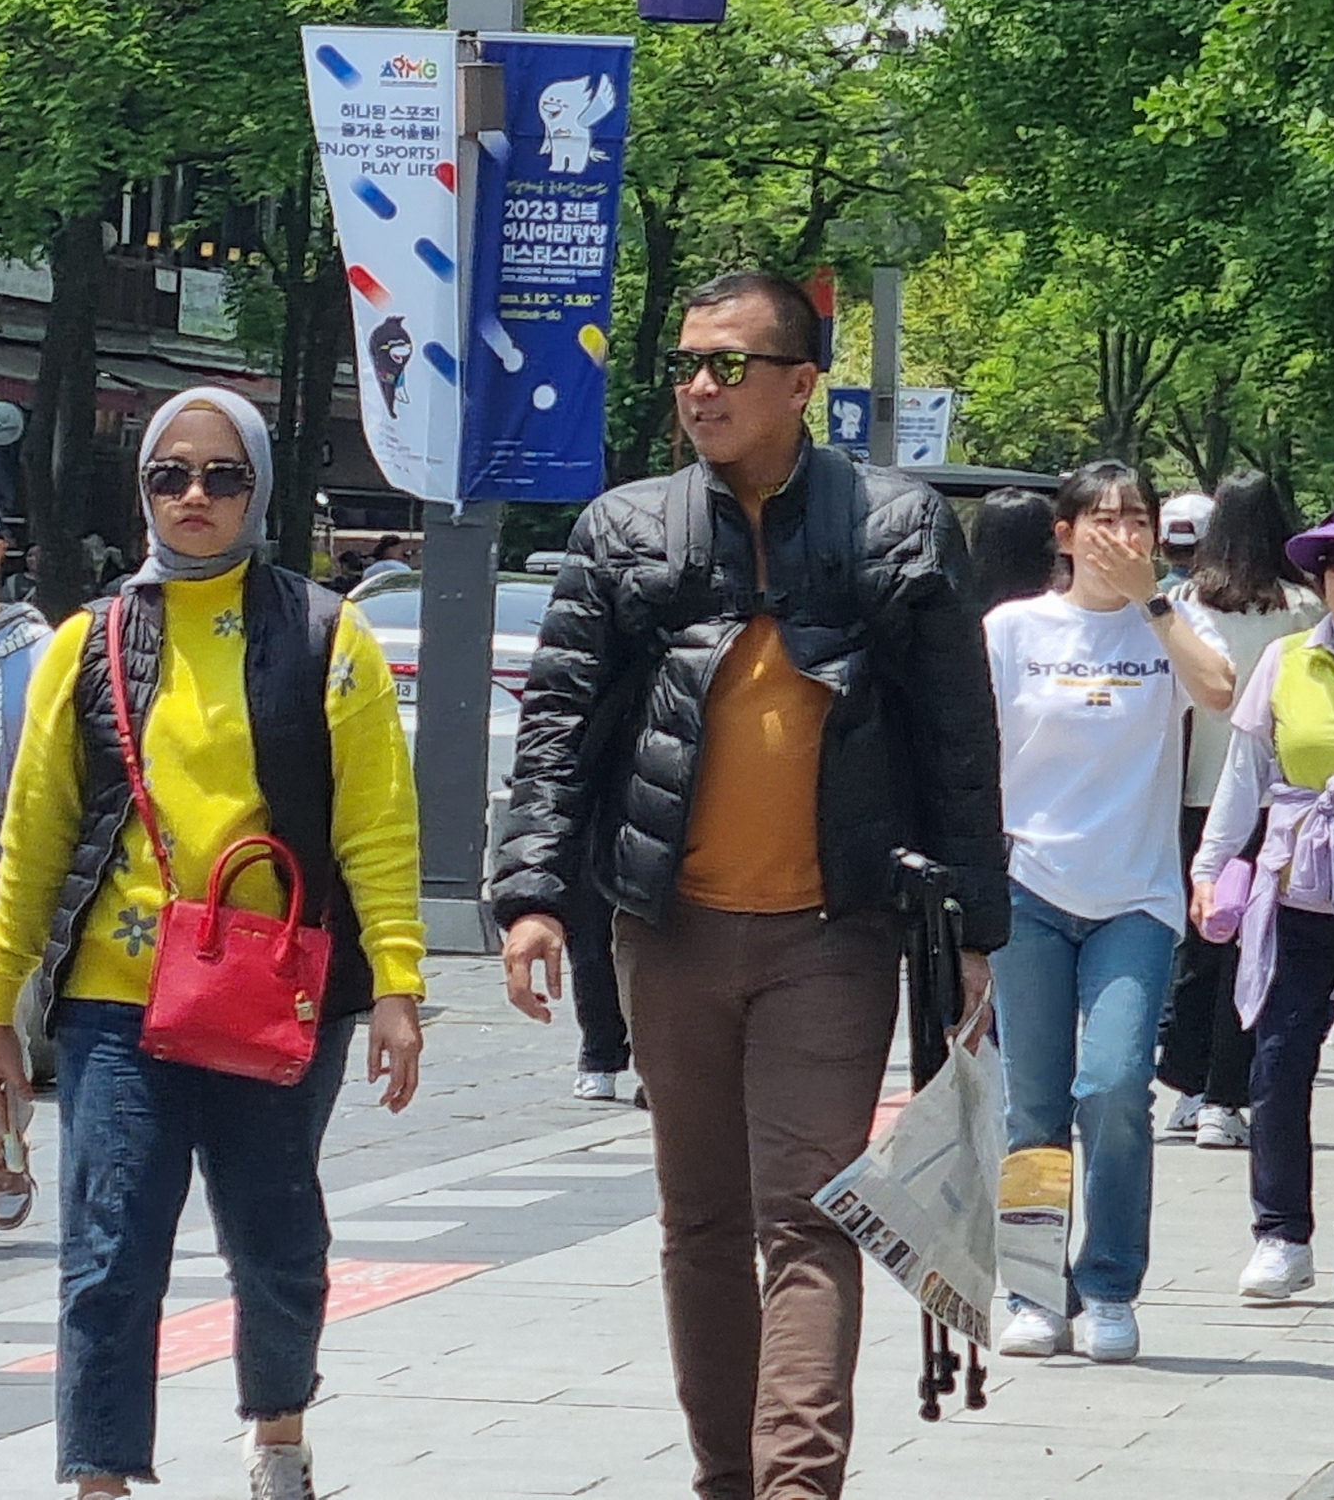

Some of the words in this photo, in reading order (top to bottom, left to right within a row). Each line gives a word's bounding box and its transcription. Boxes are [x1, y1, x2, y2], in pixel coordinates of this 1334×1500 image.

[340, 103, 386, 120] 하나된
[318, 142, 370, 158] ENJOY
[374, 144, 440, 160] SPORTS!
[361, 161, 401, 176] PLAY
[504, 199, 558, 221] 2023
[1026, 658, 1170, 678] STOCKHOLM
